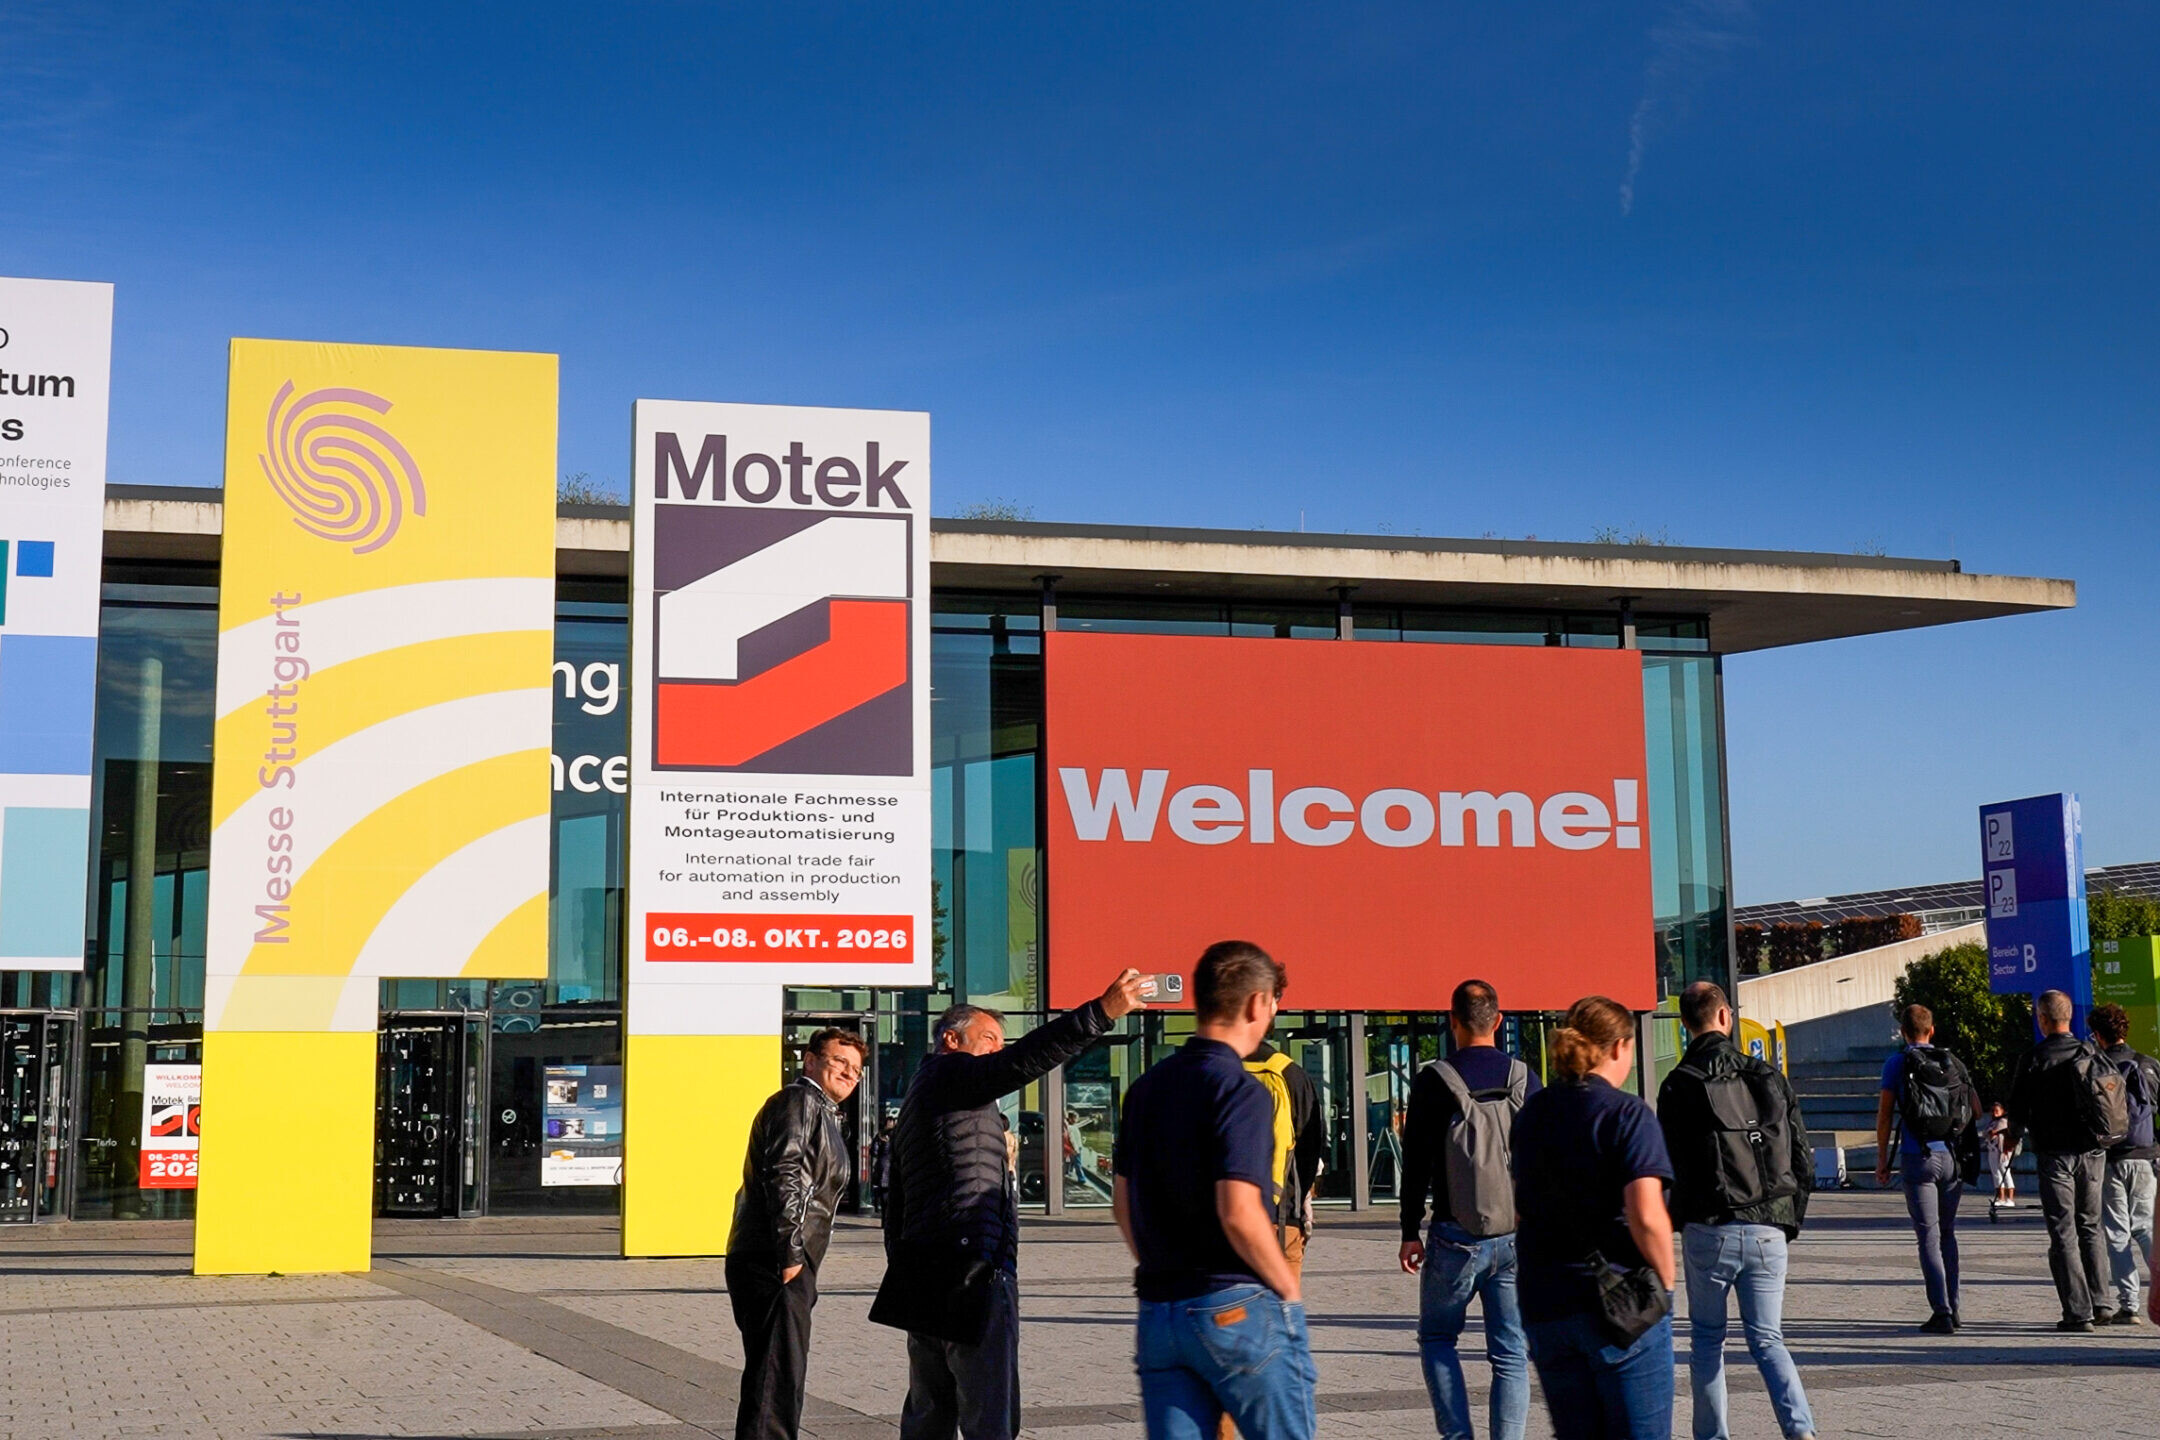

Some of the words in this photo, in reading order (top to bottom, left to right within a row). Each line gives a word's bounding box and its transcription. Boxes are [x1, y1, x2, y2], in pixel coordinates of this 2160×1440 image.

[654, 431, 912, 509] Motek
[258, 590, 311, 790] Stuttgart
[660, 790, 788, 804] Internationale
[794, 793, 899, 807] Fachmesse
[1058, 766, 1642, 851] Welcome!
[684, 808, 711, 821] für
[717, 809, 835, 823] Produktions-
[841, 811, 876, 824] und
[664, 826, 896, 844] Montageautomatisierung
[1988, 818, 2000, 849] P
[1999, 840, 2012, 857] 22
[685, 853, 792, 867] International
[797, 854, 843, 867] trade
[848, 855, 876, 867] fair
[253, 806, 295, 944] Messe
[659, 870, 683, 882] for
[688, 871, 785, 884] automation
[790, 872, 805, 884] in
[810, 873, 901, 886] production
[721, 889, 754, 901] and
[759, 889, 841, 904] assembly
[1991, 874, 2003, 905] P
[2002, 896, 2015, 913] 23
[764, 928, 830, 949] OKT.
[837, 929, 908, 950] 2026
[2023, 943, 2037, 973] B
[1993, 963, 2017, 976] Sector
[151, 1095, 184, 1105] Motek
